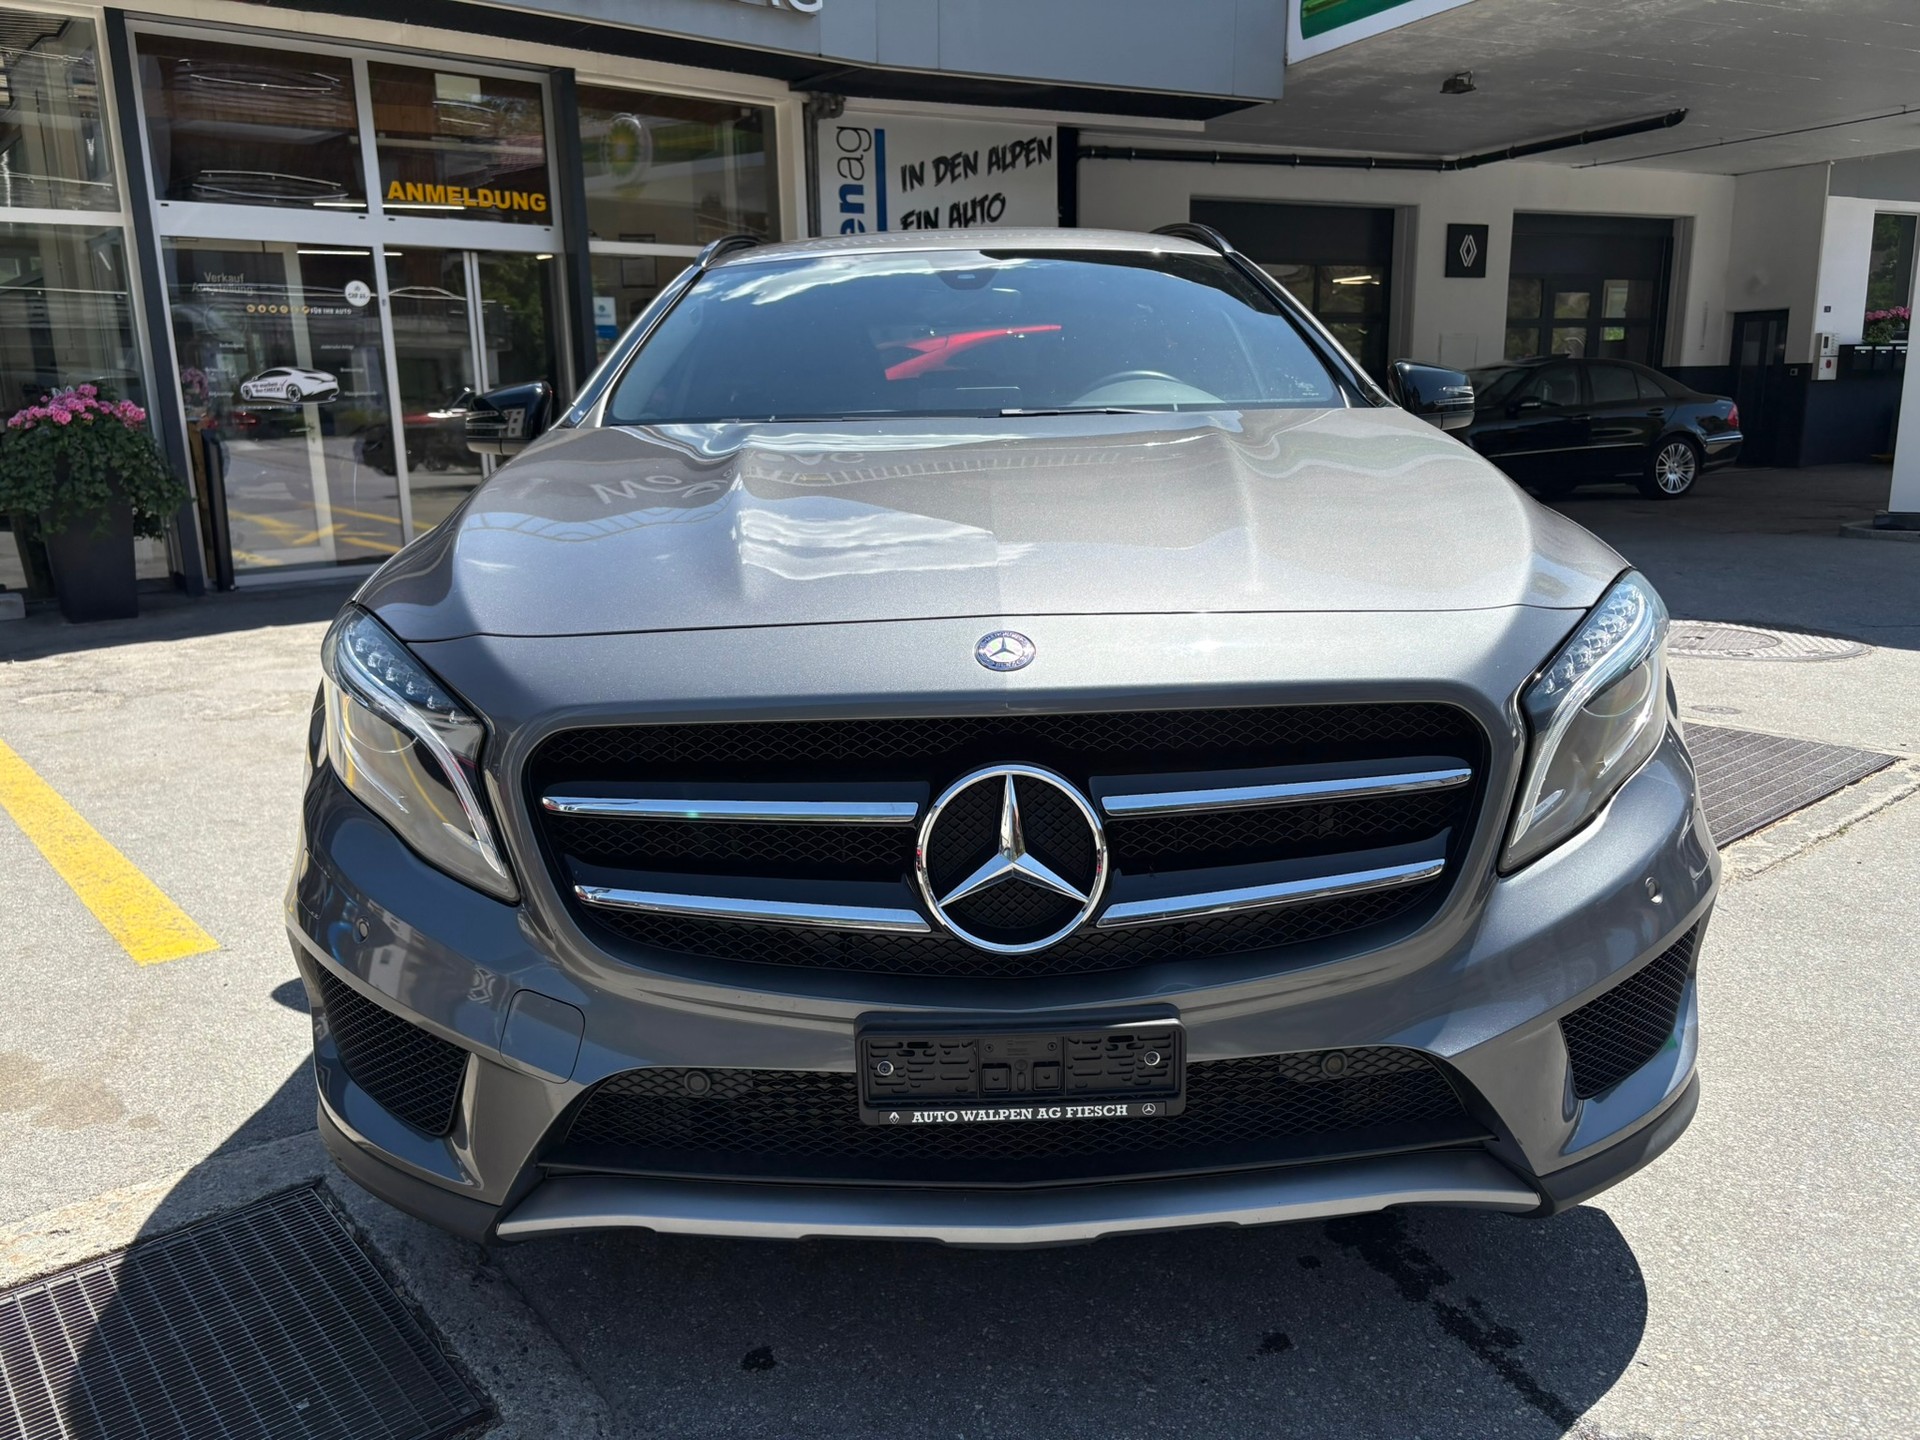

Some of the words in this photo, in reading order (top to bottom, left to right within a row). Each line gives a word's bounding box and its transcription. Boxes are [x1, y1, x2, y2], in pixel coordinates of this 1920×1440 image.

[901, 161, 925, 193] IN
[932, 150, 979, 187] DEN
[987, 136, 1053, 176] ALPEN
[387, 180, 547, 212] ANMELDUNG
[948, 192, 1006, 229] AUTO
[203, 272, 245, 283] Verkauf
[912, 1110, 958, 1123] AUTO
[960, 1108, 1033, 1121] WALPEN
[1036, 1107, 1061, 1119] AG
[1065, 1104, 1128, 1118] FIESCH
